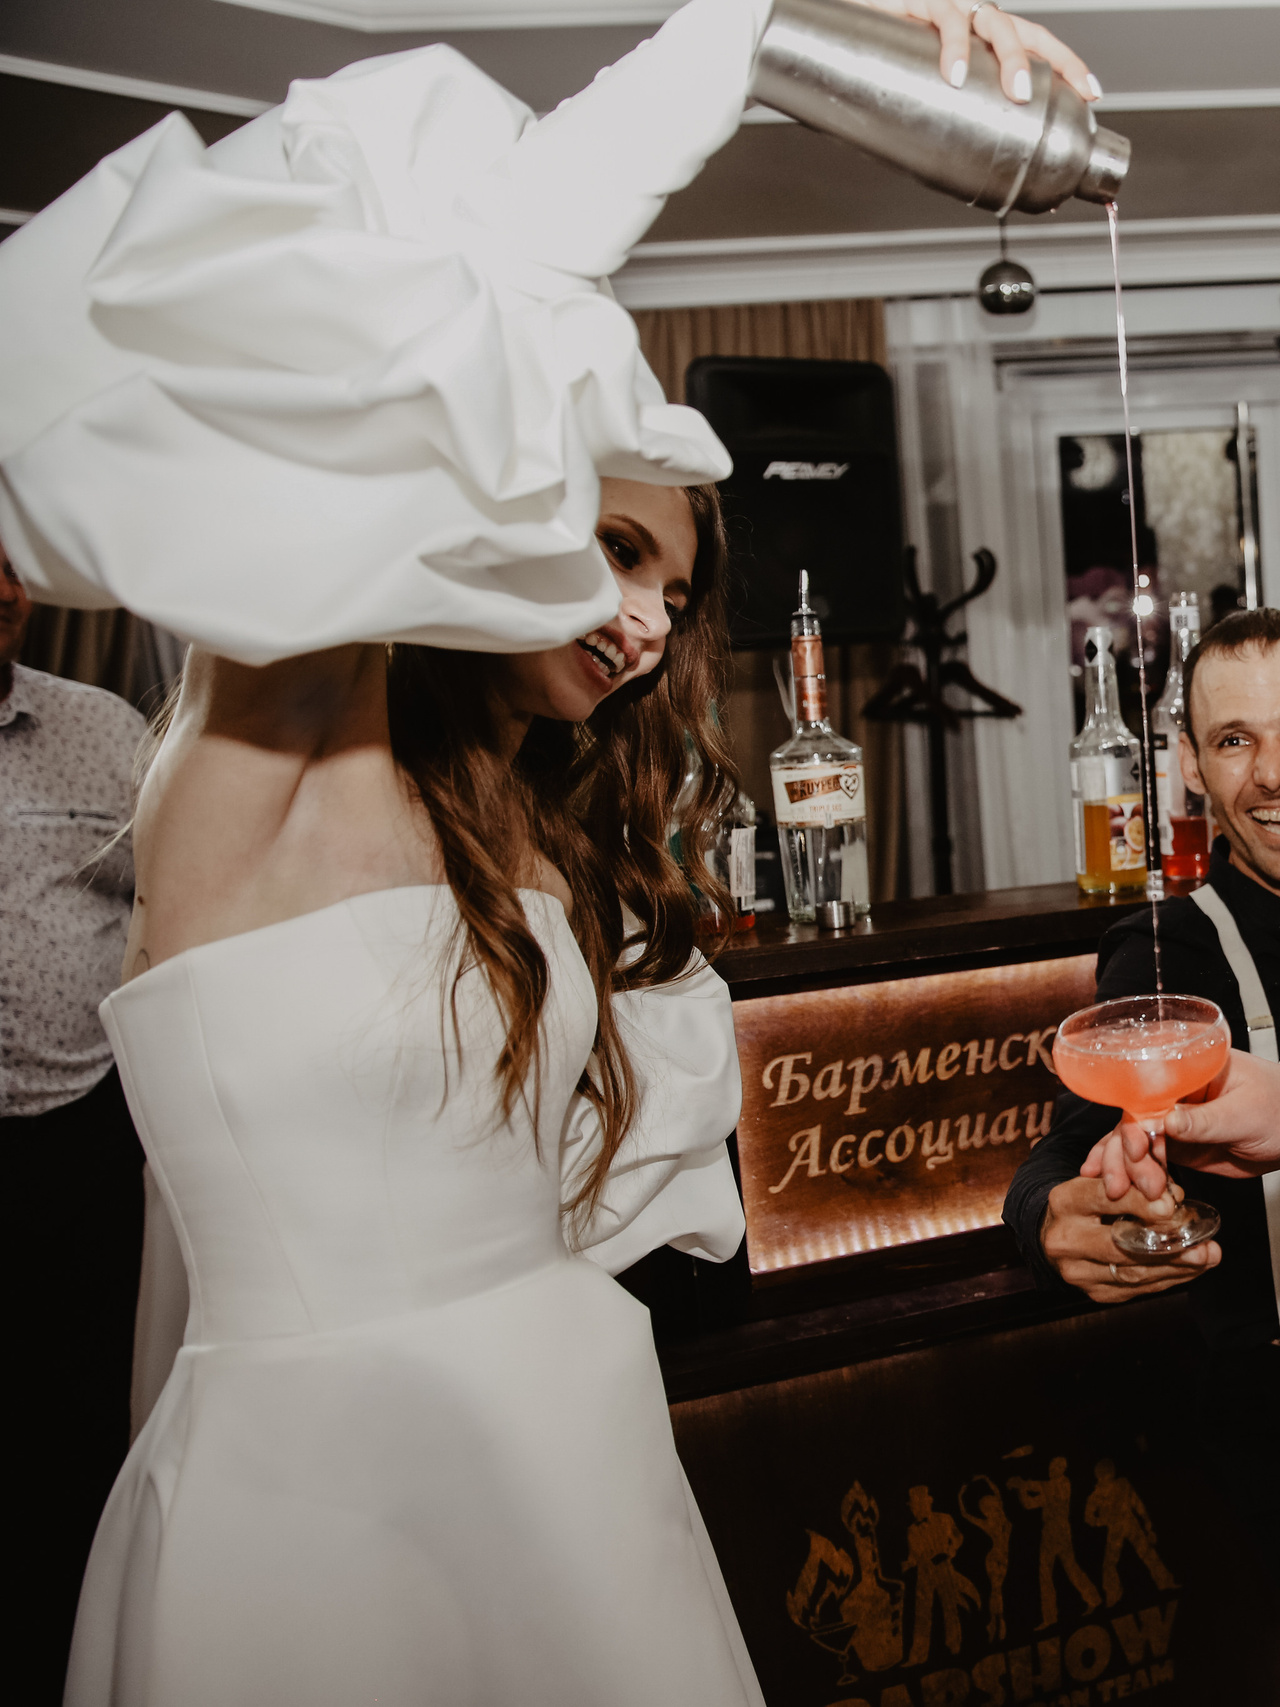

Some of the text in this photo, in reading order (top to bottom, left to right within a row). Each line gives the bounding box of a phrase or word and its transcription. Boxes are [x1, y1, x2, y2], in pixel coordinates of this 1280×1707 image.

[762, 461, 850, 480] PEAVEY
[762, 1026, 1058, 1116] Барменск
[1096, 1658, 1176, 1704] TEAM
